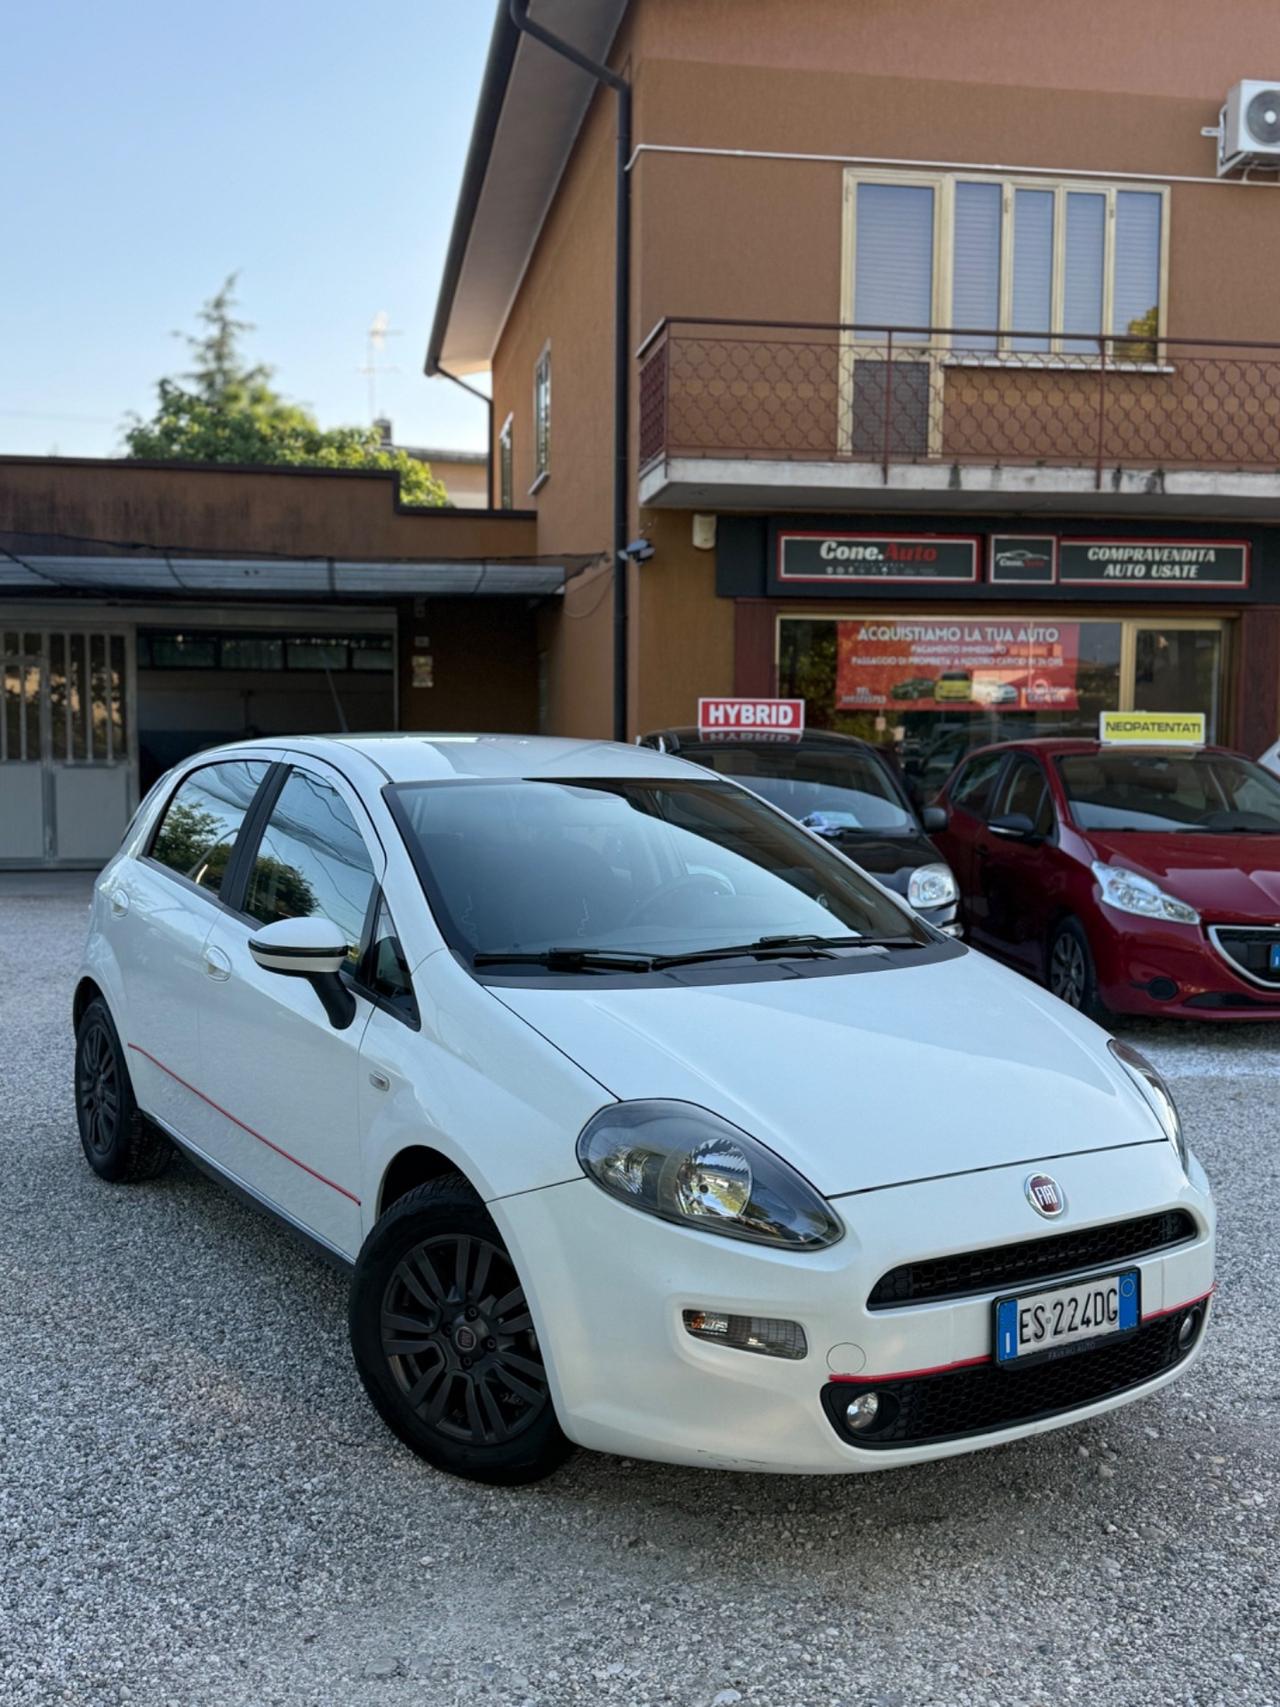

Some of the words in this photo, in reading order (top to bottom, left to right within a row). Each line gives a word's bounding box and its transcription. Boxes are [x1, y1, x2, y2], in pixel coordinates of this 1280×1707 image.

[1087, 547, 1216, 562] COMPRAVENDITA
[1104, 563, 1146, 577] AUTO
[1150, 564, 1200, 578] USATE
[858, 626, 961, 641] ACQUISTIAMO
[964, 627, 982, 641] LA
[985, 627, 1014, 641] TUA
[1016, 627, 1059, 642] AUTO
[708, 704, 793, 725] HYBRID
[1105, 721, 1201, 733] NEOPATENTATI
[1034, 1185, 1058, 1206] FIAT
